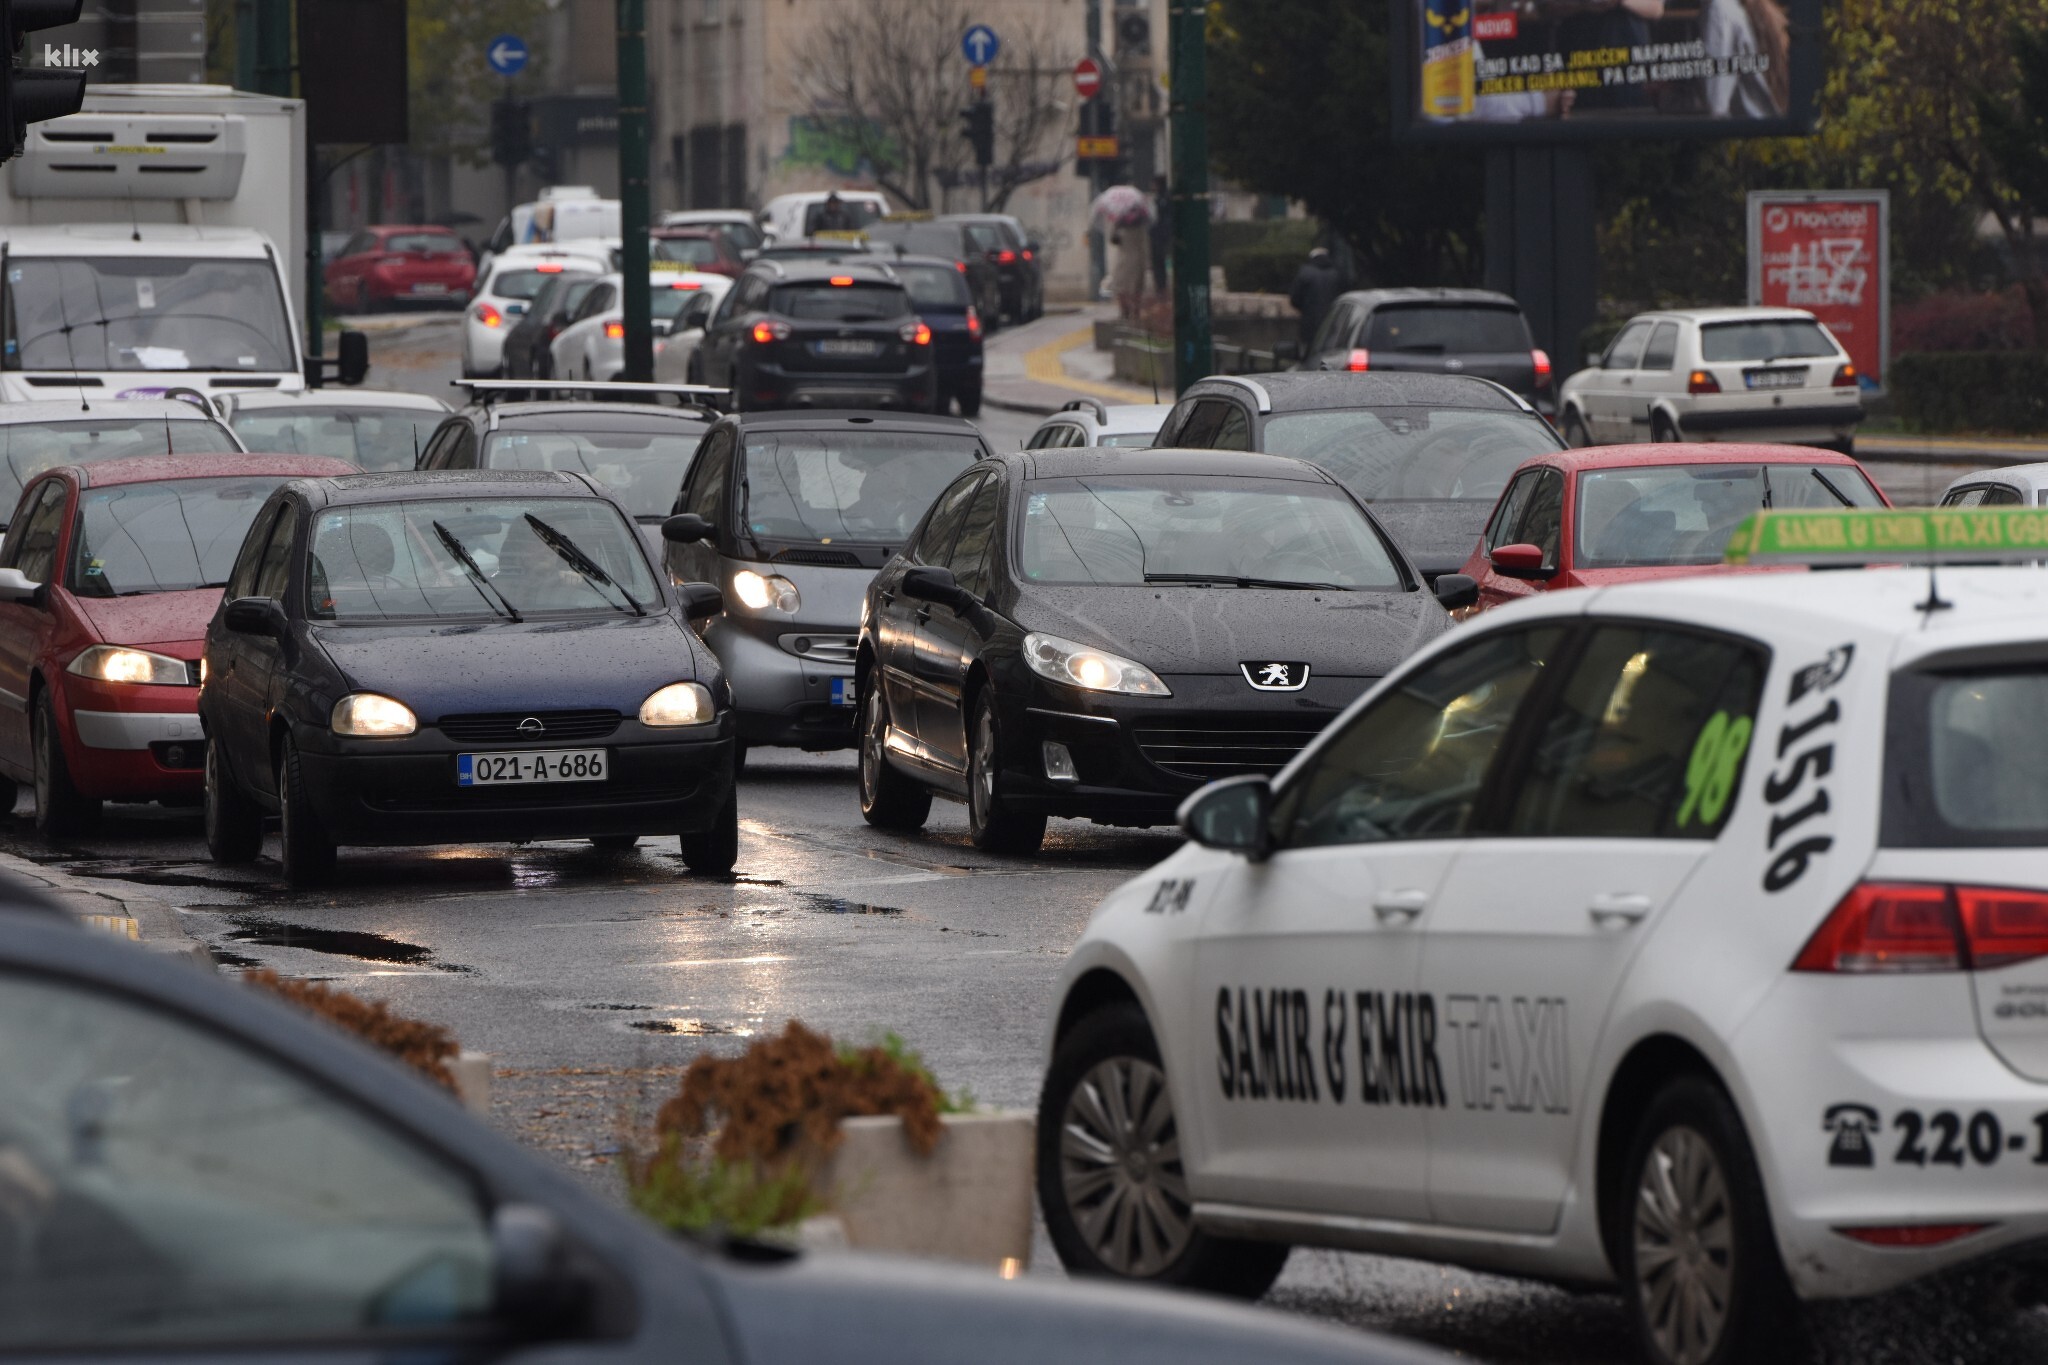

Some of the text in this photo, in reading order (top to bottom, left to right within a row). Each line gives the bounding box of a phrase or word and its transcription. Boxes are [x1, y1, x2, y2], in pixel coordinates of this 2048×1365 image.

[1475, 18, 1513, 35] NOVO
[1510, 54, 1541, 72] KAD
[1543, 52, 1564, 71] SA
[1480, 75, 1525, 95] JOKER
[1603, 66, 1625, 86] PA
[1626, 64, 1648, 84] GA
[1776, 516, 1848, 548] SAMIR
[1872, 516, 1928, 547] EMIR
[1931, 514, 2002, 546] TAXI
[476, 753, 603, 781] 021-A-686
[1216, 985, 1319, 1100] SAMIR
[1355, 989, 1448, 1109] EMIR
[1446, 993, 1572, 1115] TAXI
